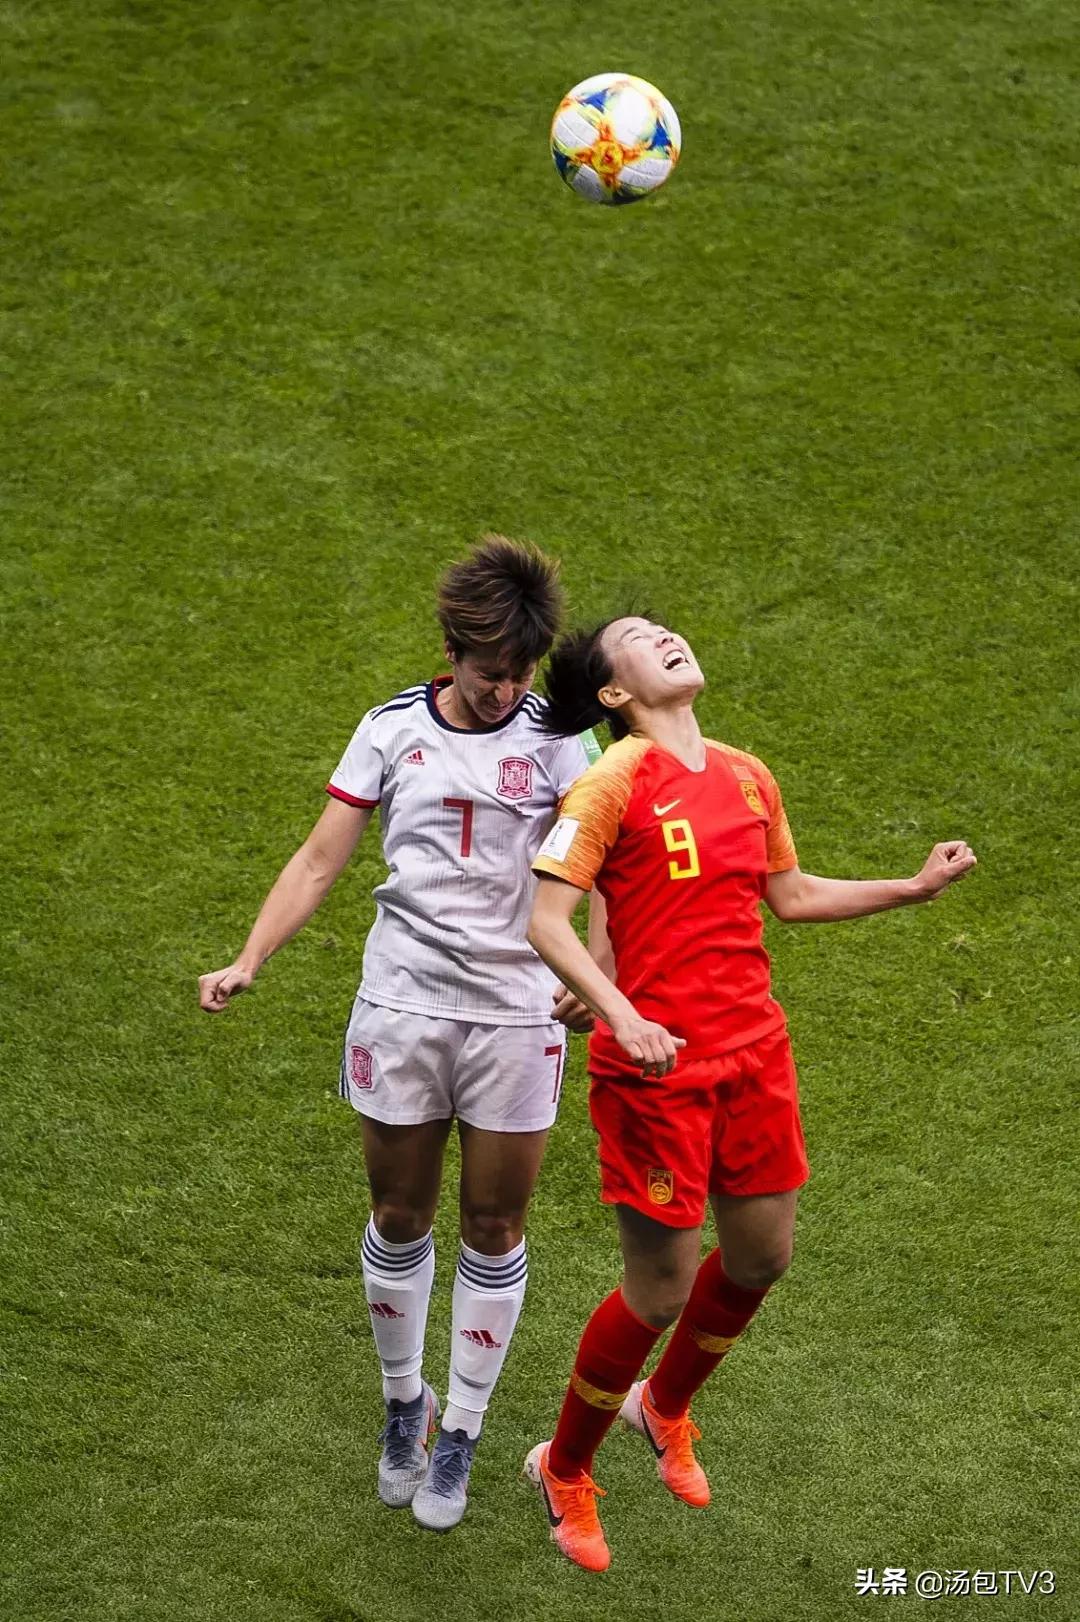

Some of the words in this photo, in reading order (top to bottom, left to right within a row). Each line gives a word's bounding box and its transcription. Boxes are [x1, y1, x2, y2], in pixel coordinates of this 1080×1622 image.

[442, 797, 473, 858] 7
[662, 818, 701, 881] 9
[544, 1044, 563, 1104] 7
